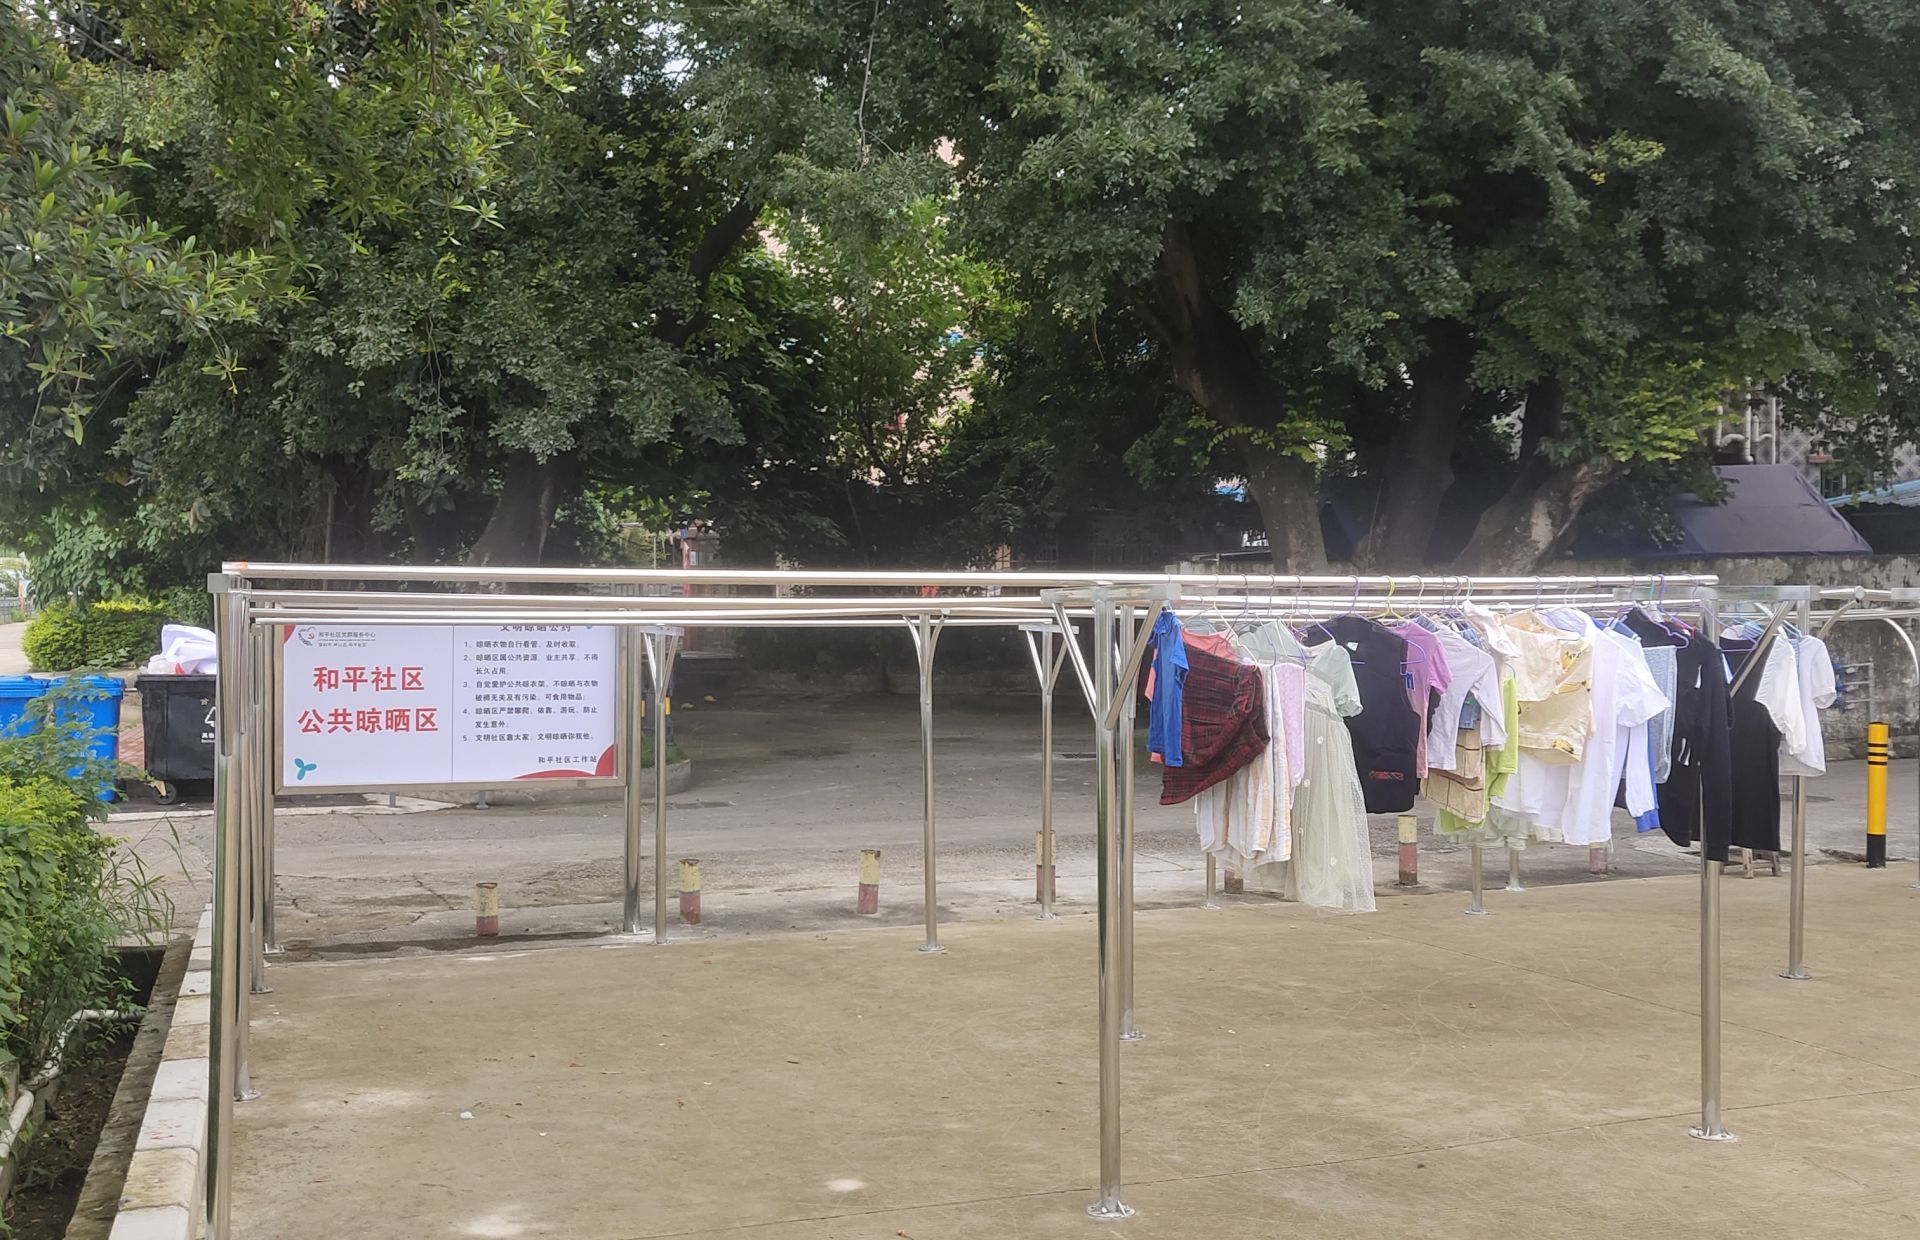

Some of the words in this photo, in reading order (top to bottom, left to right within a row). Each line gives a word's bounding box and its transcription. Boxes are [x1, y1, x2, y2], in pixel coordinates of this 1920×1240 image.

[313, 666, 425, 692] 和平社区
[297, 707, 438, 733] 公共晾晒区
[538, 755, 598, 764] 和平社区工作站
